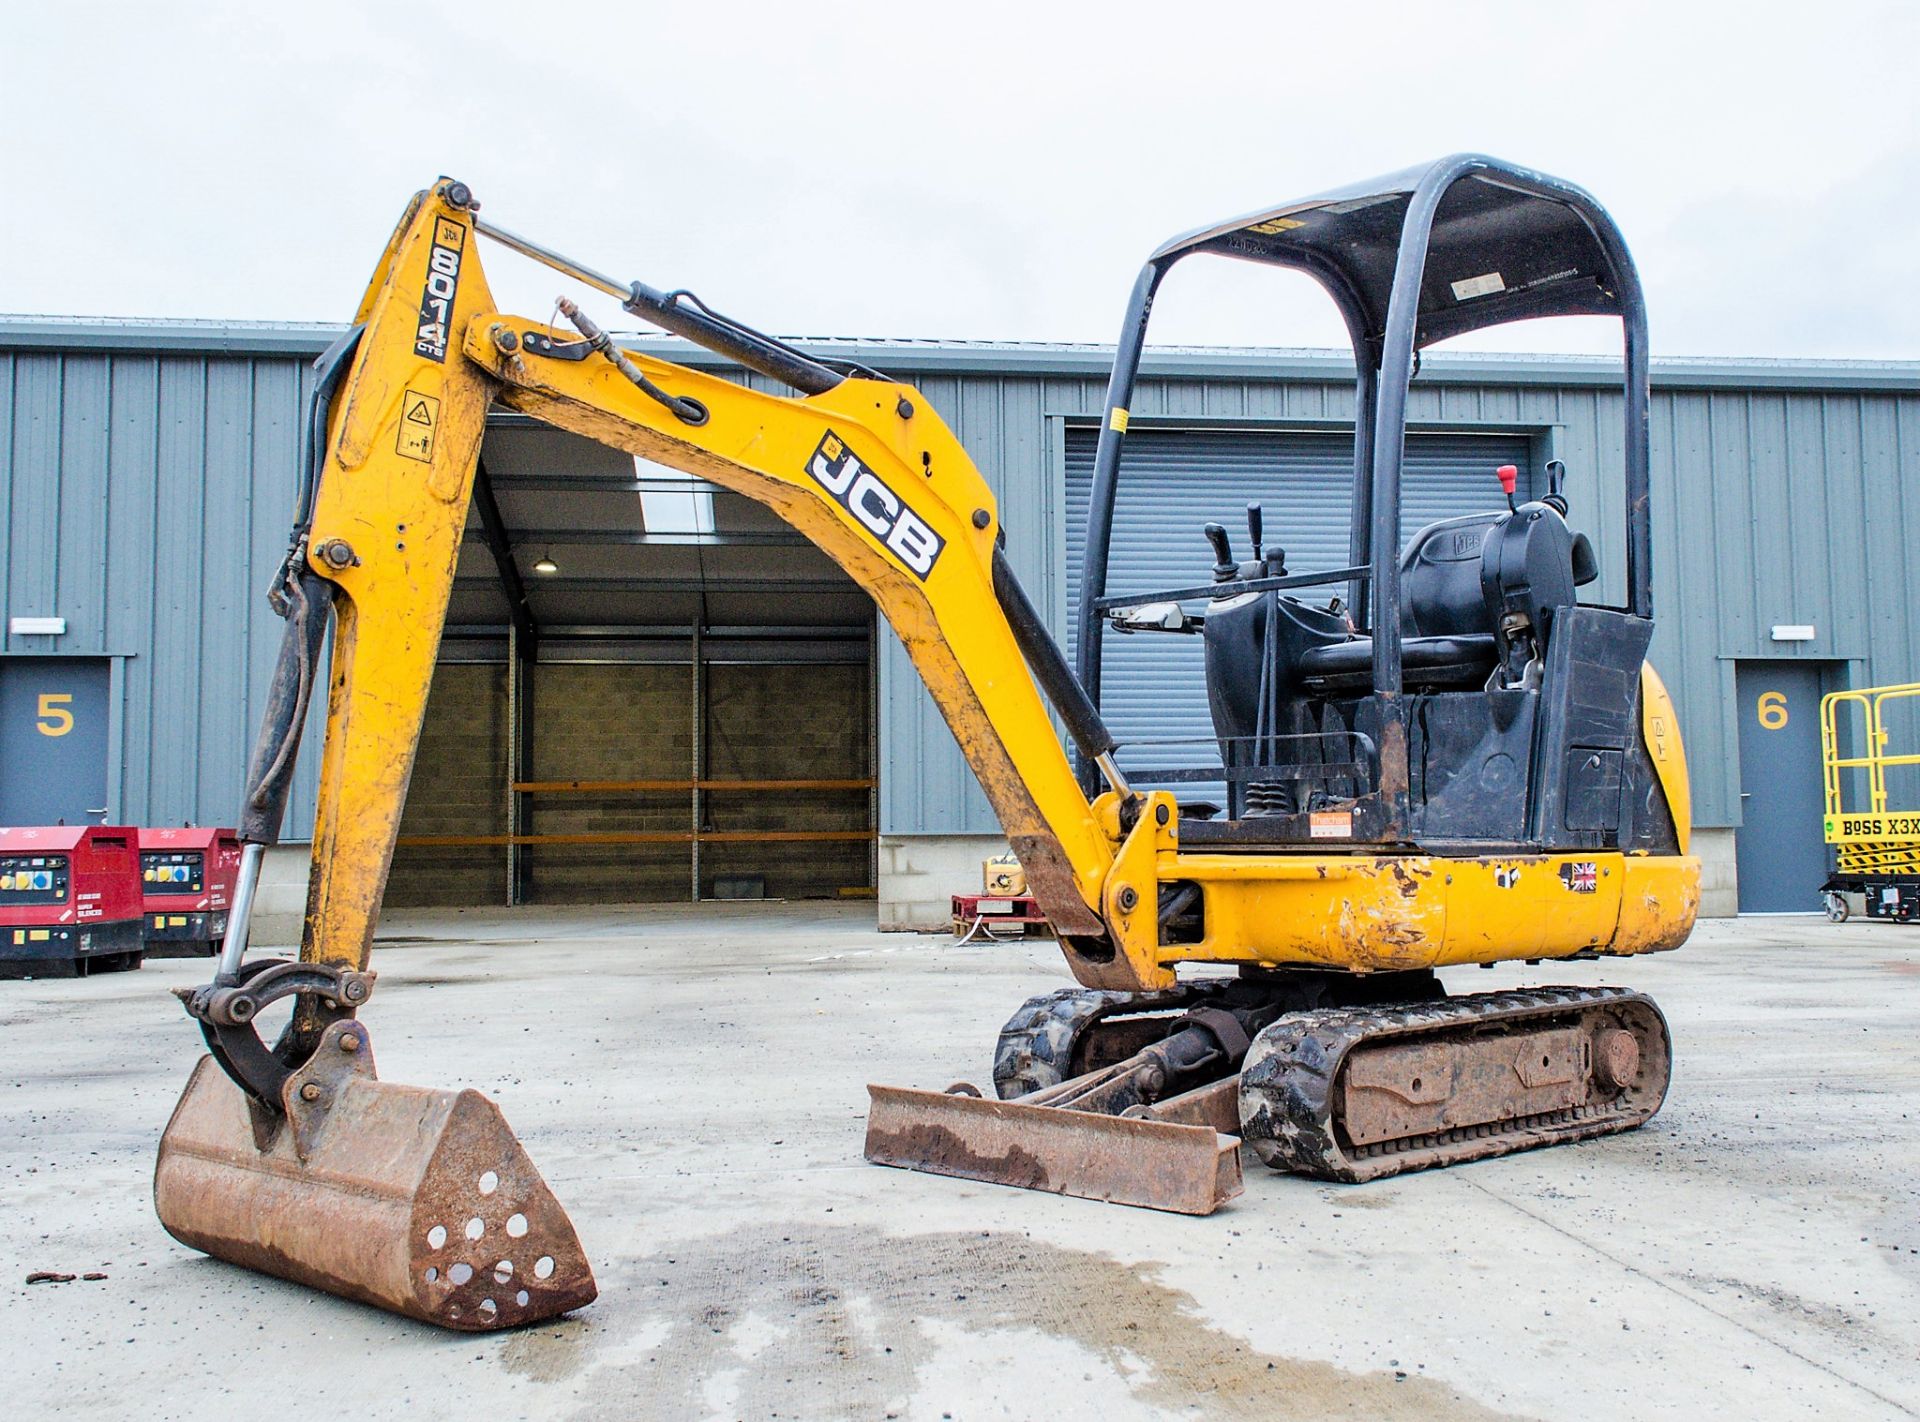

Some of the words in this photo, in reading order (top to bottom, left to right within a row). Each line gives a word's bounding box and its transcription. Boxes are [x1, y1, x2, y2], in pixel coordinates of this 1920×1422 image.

[418, 246, 459, 348] 8014
[417, 342, 444, 357] CTS
[812, 454, 939, 574] JCB
[36, 693, 74, 737] 5
[1757, 691, 1789, 730] 6
[1843, 820, 1882, 836] BOSS
[1888, 818, 1920, 835] X3X
